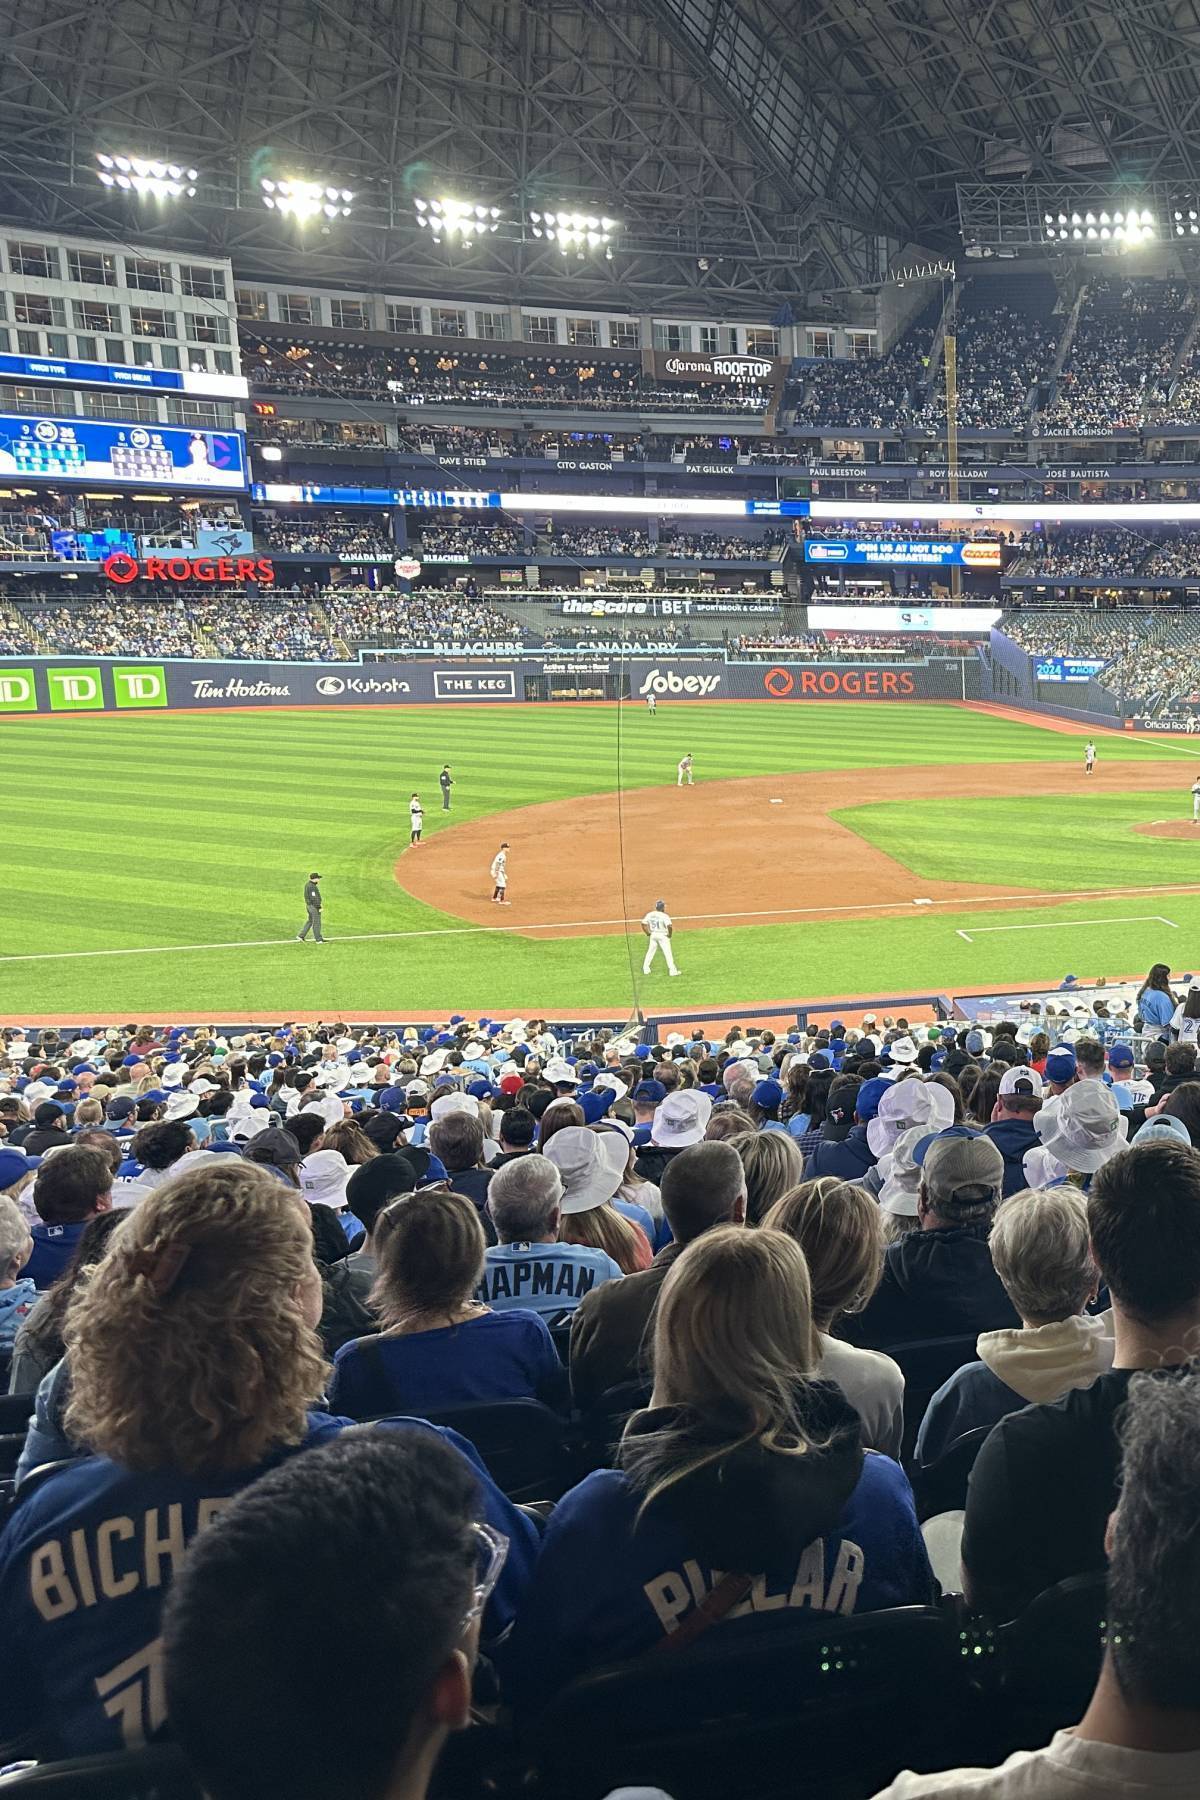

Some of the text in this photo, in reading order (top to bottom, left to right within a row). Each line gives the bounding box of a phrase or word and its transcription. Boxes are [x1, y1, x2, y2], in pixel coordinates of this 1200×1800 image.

[665, 358, 772, 377] Corona ROOFTOP
[730, 376, 756, 384] PATIO
[1043, 428, 1114, 437] JACKIE ROBINSON
[439, 457, 487, 466] DAVE STIEB
[556, 461, 613, 471] CITO GASTON
[686, 465, 734, 474] PAT GILLICK
[809, 468, 867, 477] PAUL BEESTON
[929, 469, 989, 479] ROY HALLADAY
[1070, 469, 1110, 479] BAUTISTA
[880, 543, 893, 553] US
[895, 543, 908, 553] AT
[338, 553, 469, 562] CANADA DRY BLEACHERS
[146, 557, 275, 582] ROGERS
[562, 599, 647, 614] theScore
[662, 600, 692, 615] BET
[1036, 664, 1062, 674] 2024
[118, 674, 161, 699] TD
[347, 678, 410, 693] Kubota
[444, 679, 507, 690] THE KEG
[639, 669, 721, 696] Sobeys
[801, 671, 915, 694] ROGERS
[0, 675, 97, 702] D TD
[191, 678, 290, 699] Tim Hortons
[1144, 720, 1170, 730] Official
[1171, 721, 1200, 732] Roog
[474, 1262, 595, 1303] HAPMAN
